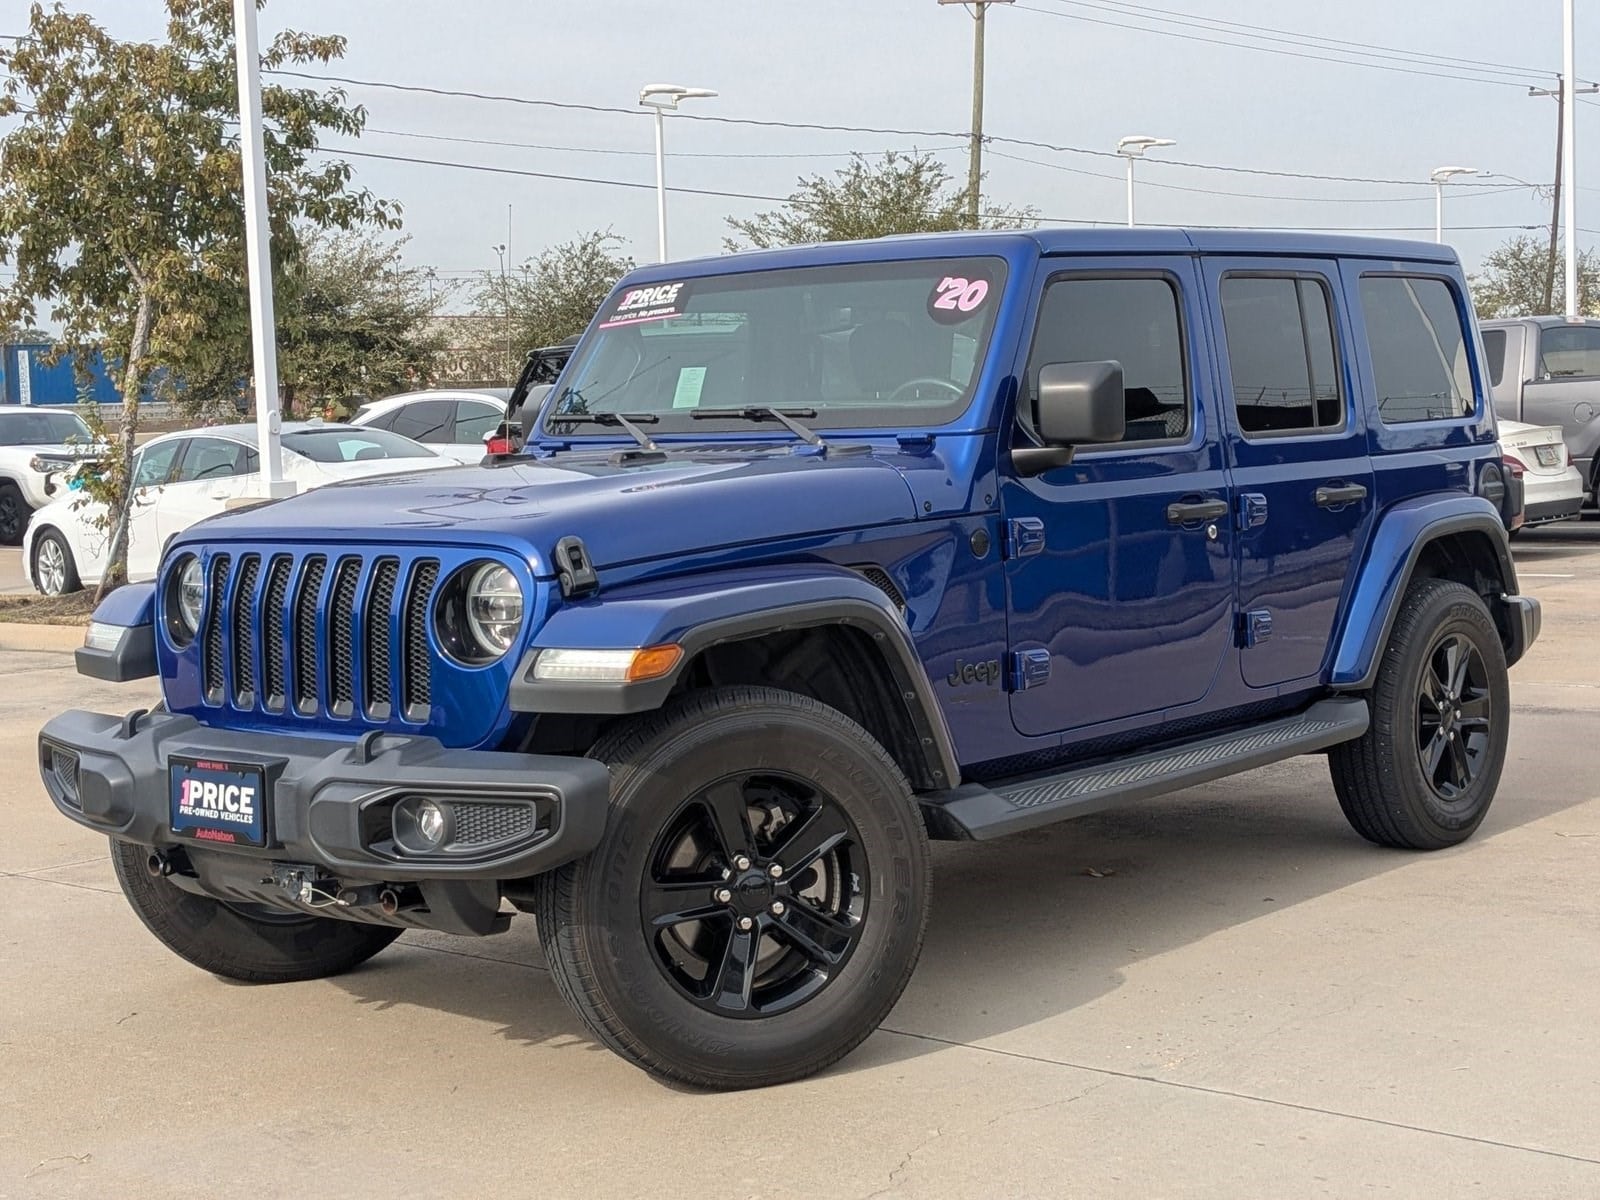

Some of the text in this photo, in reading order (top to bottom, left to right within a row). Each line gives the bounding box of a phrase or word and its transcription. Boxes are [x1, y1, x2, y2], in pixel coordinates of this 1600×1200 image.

[621, 283, 684, 306] 1PRICE
[947, 659, 1000, 687] Jeep
[180, 779, 255, 814] 1PRICE
[179, 806, 253, 824] PRE-OWNED VEHICLES
